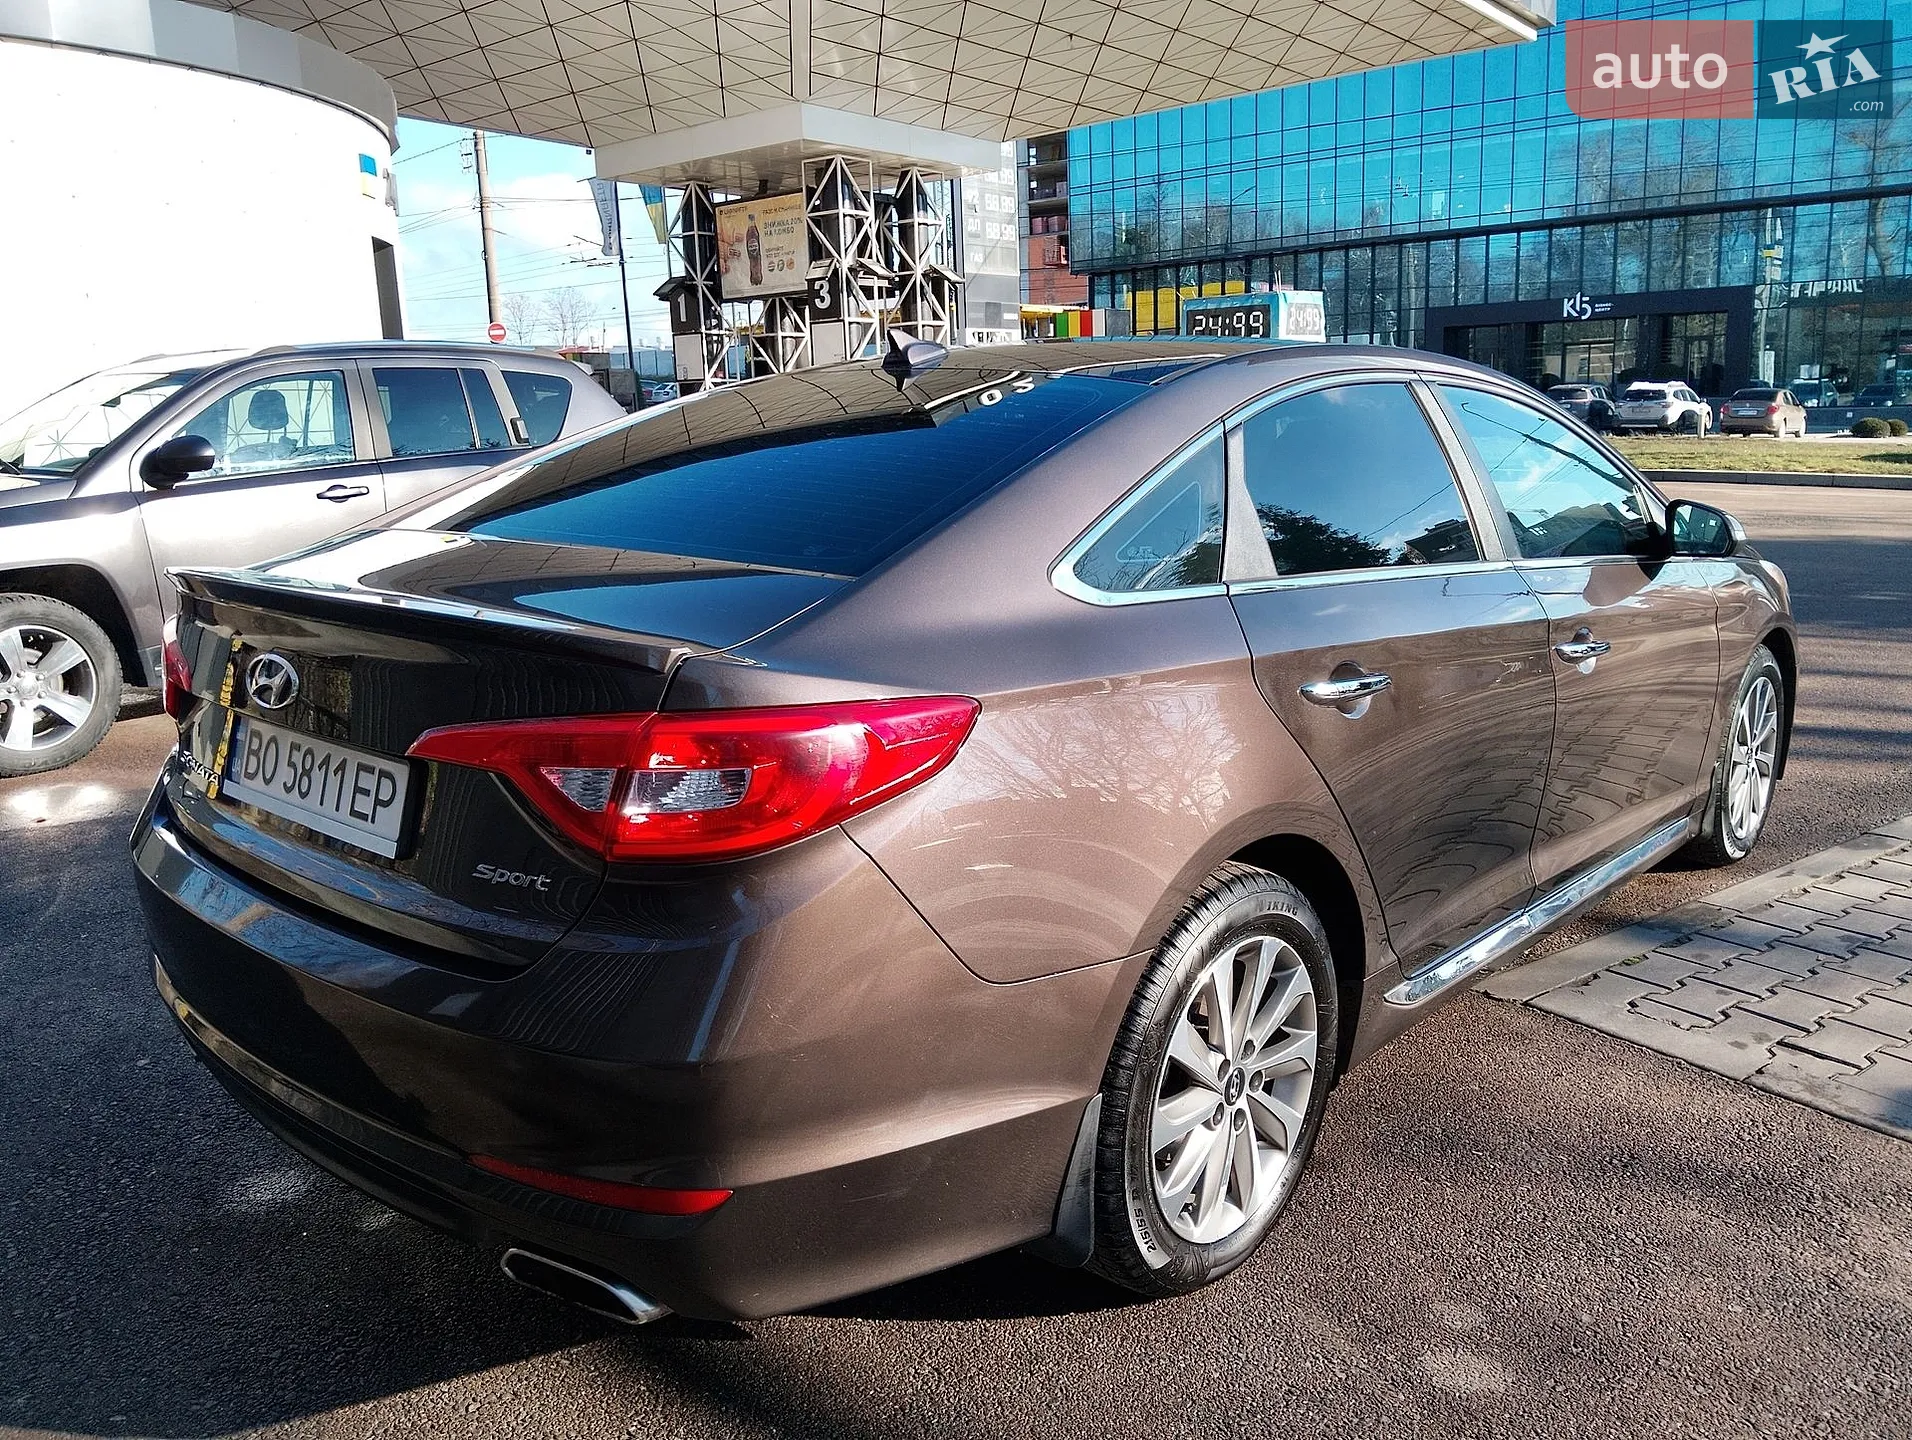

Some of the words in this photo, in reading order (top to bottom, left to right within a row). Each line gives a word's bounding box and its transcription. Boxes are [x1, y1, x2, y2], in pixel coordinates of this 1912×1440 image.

[677, 293, 687, 323] 1
[813, 280, 831, 310] 3
[243, 728, 279, 786] BO
[283, 740, 347, 813] 5811
[349, 761, 397, 825] EP
[471, 863, 553, 892] Sport
